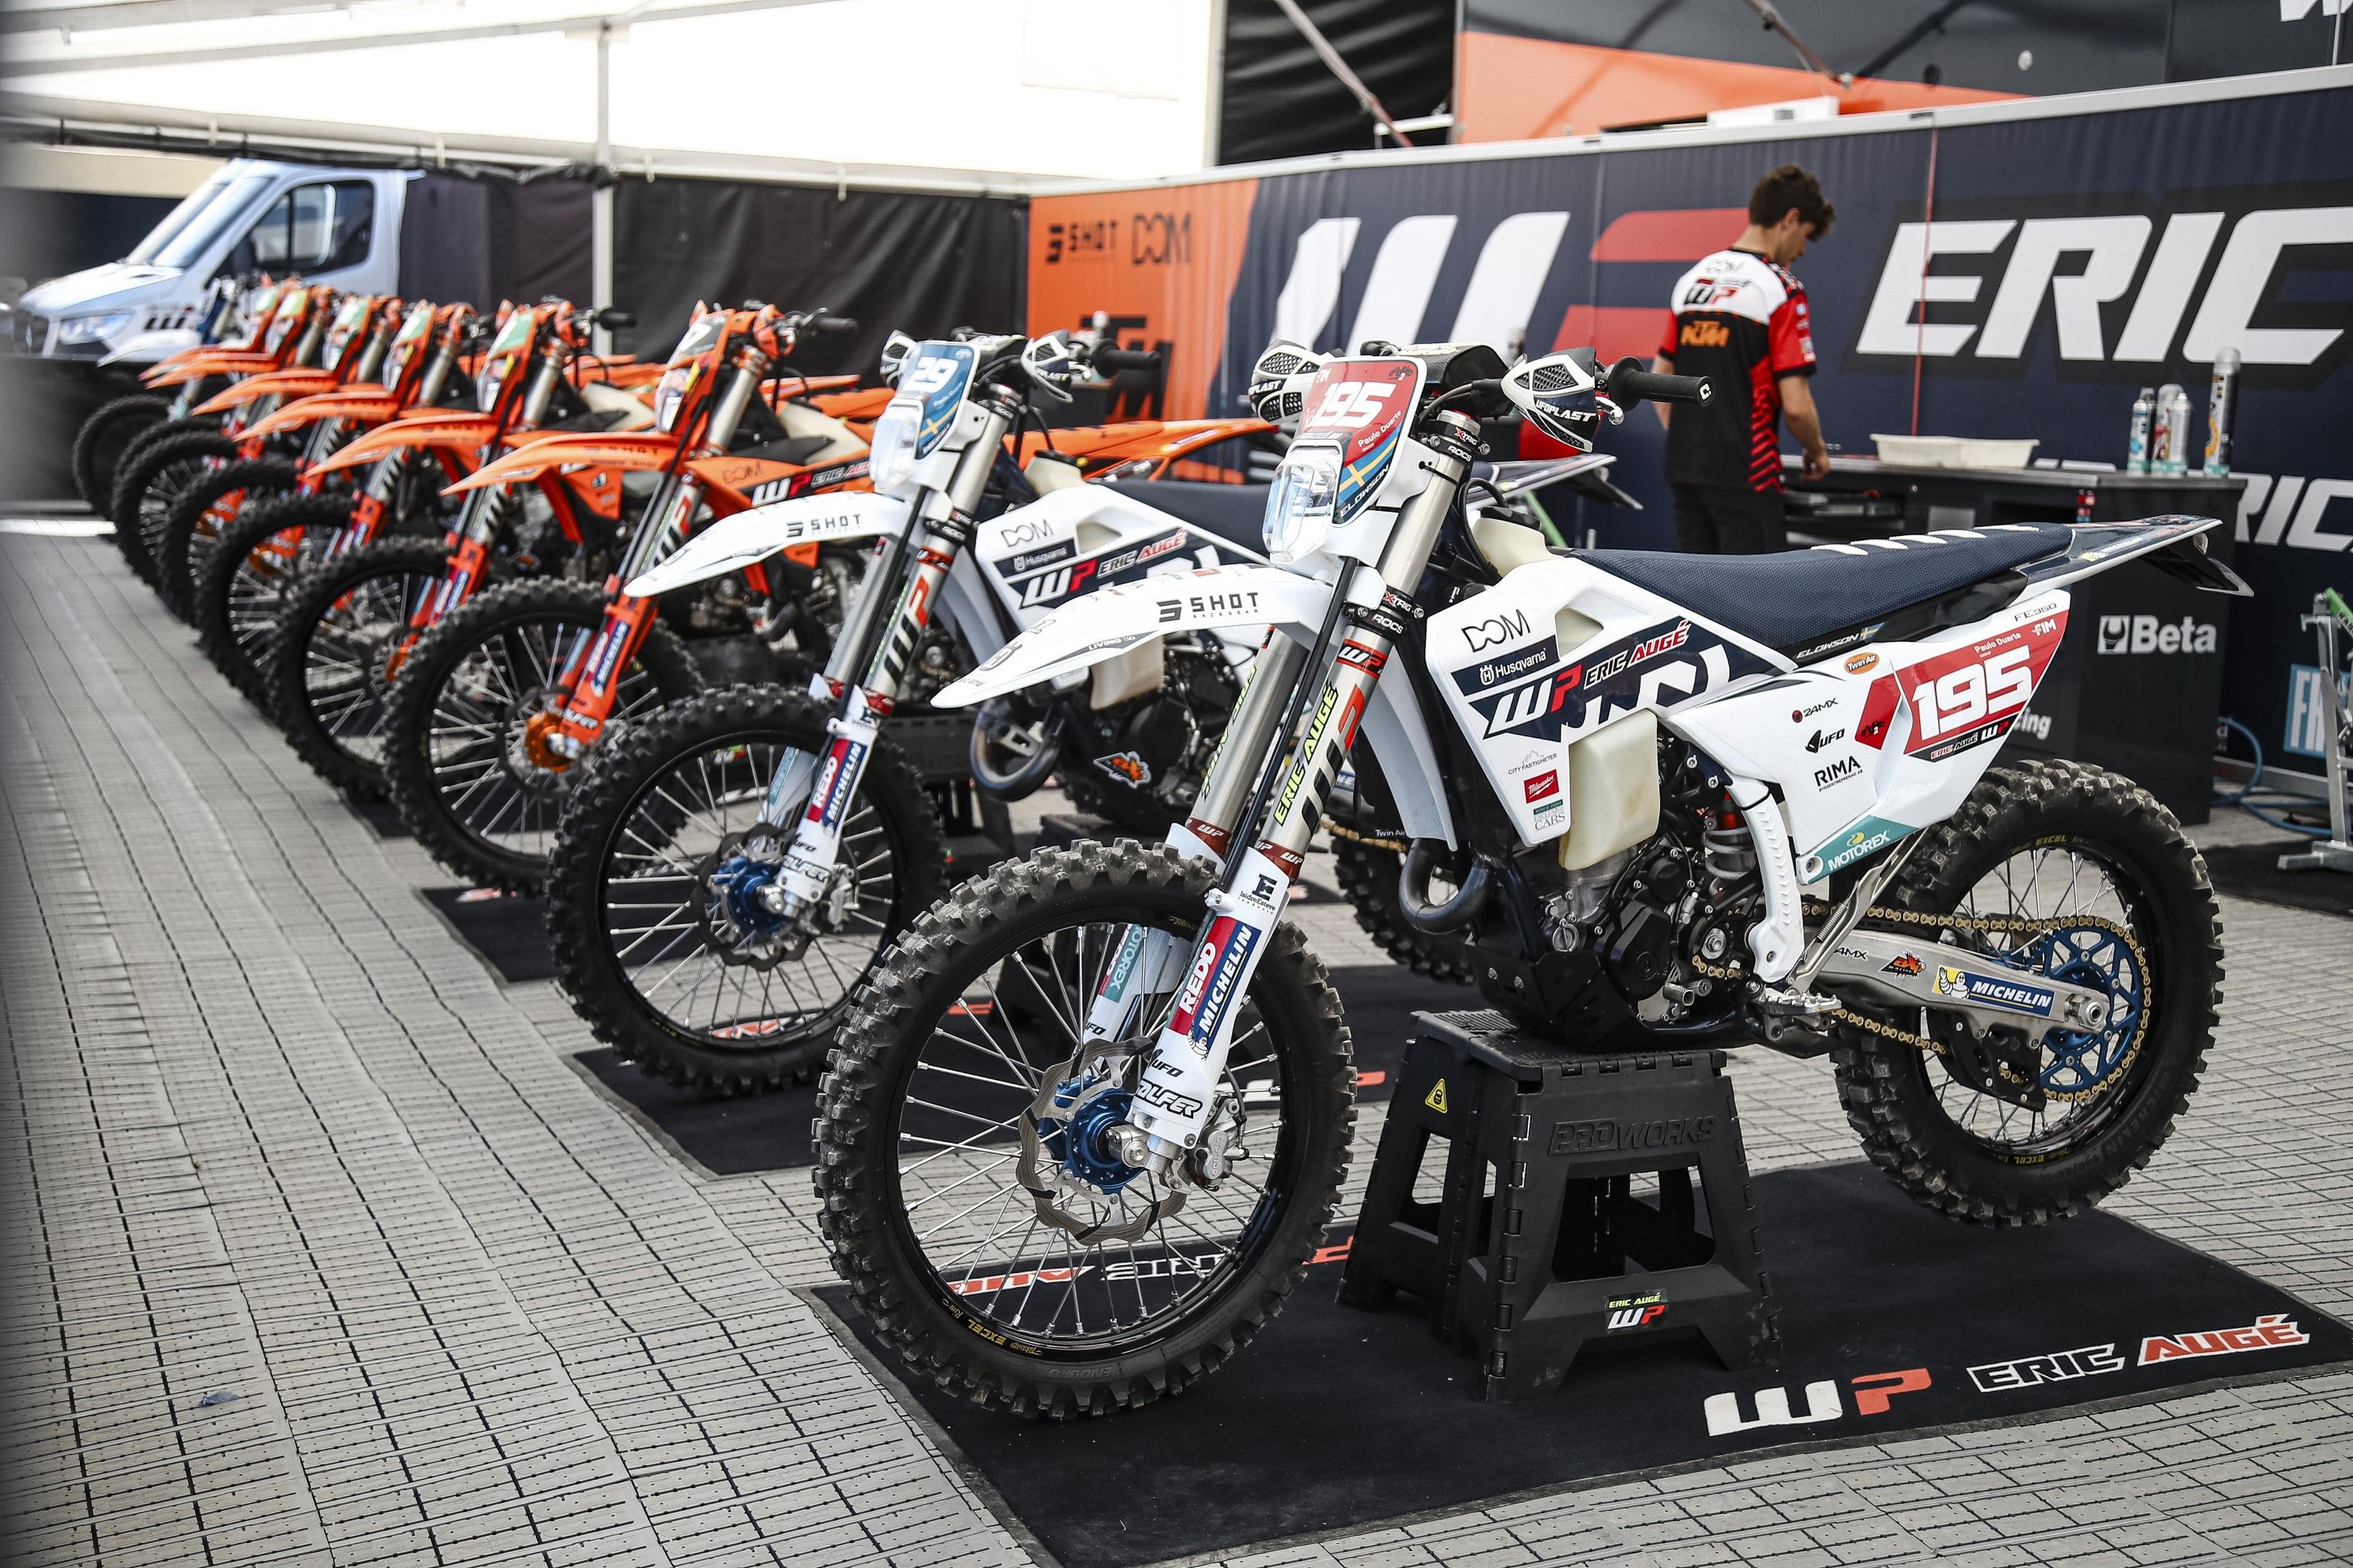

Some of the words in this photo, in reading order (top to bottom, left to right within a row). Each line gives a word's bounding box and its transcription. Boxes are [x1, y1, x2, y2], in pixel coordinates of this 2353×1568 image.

[1857, 206, 2353, 365] ERIC
[1680, 320, 1730, 348] KTM
[902, 355, 960, 394] 29
[1305, 380, 1397, 429] 195
[1535, 397, 1597, 423] UFOPLAST
[1357, 430, 1380, 448] Paulo
[1379, 409, 1402, 433] Duarte
[751, 473, 813, 508] WP
[1339, 464, 1390, 518] ELOWSON
[810, 513, 862, 532] SHOT
[1000, 517, 1054, 548] DOM
[1021, 558, 1098, 608] WP
[1097, 549, 1139, 579] ERIC
[1189, 591, 1259, 612] SHOT
[1372, 612, 1405, 635] ROCS
[1460, 608, 1531, 653] DOM
[2033, 618, 2057, 637] FIM
[2130, 614, 2218, 654] Beta
[1796, 633, 1860, 660] ELOWSON
[1973, 641, 1997, 654] Paulo
[1995, 631, 2022, 646] Duarte
[1488, 663, 1583, 735] WP
[1583, 649, 1629, 691] ERIC
[1626, 619, 1691, 669] AUGÉ
[1495, 648, 1547, 678] Husqvarna
[1847, 659, 1866, 673] Twin
[1865, 653, 1878, 666] Air
[1803, 696, 1839, 718] 24MX
[1911, 644, 2033, 742] 195
[1273, 757, 1306, 827] ERIC
[1301, 678, 1339, 765] AUGÉ
[1819, 727, 1845, 749] UFO
[1508, 767, 1521, 775] CITY
[1521, 753, 1558, 770] FASTIGHETER
[1813, 755, 1861, 787] RIMA
[825, 742, 862, 820] MICHELIN
[1375, 828, 1396, 837] Twin
[1534, 813, 1566, 831] CARS
[1828, 830, 1891, 873] MOTOREX
[2035, 835, 2067, 847] EXCEL
[1279, 851, 1304, 867] WP
[1110, 925, 1143, 990] OTOREX
[1835, 946, 1870, 961] 4MX
[1178, 941, 1217, 1016] REDD
[1197, 924, 1253, 1035] MICHELIN
[1971, 980, 2053, 1009] MICHELIN
[1152, 1059, 1185, 1078] UFO
[1549, 1115, 1716, 1156] PROWORKS
[1608, 1299, 1632, 1309] ERIC
[1633, 1292, 1662, 1305] AUGÉ
[1607, 1304, 1666, 1330] WP
[967, 1318, 1007, 1346] EXCEL
[1704, 1367, 1933, 1437] WP
[1966, 1343, 2126, 1394] ERIC
[2137, 1313, 2311, 1367] AUGÉ
